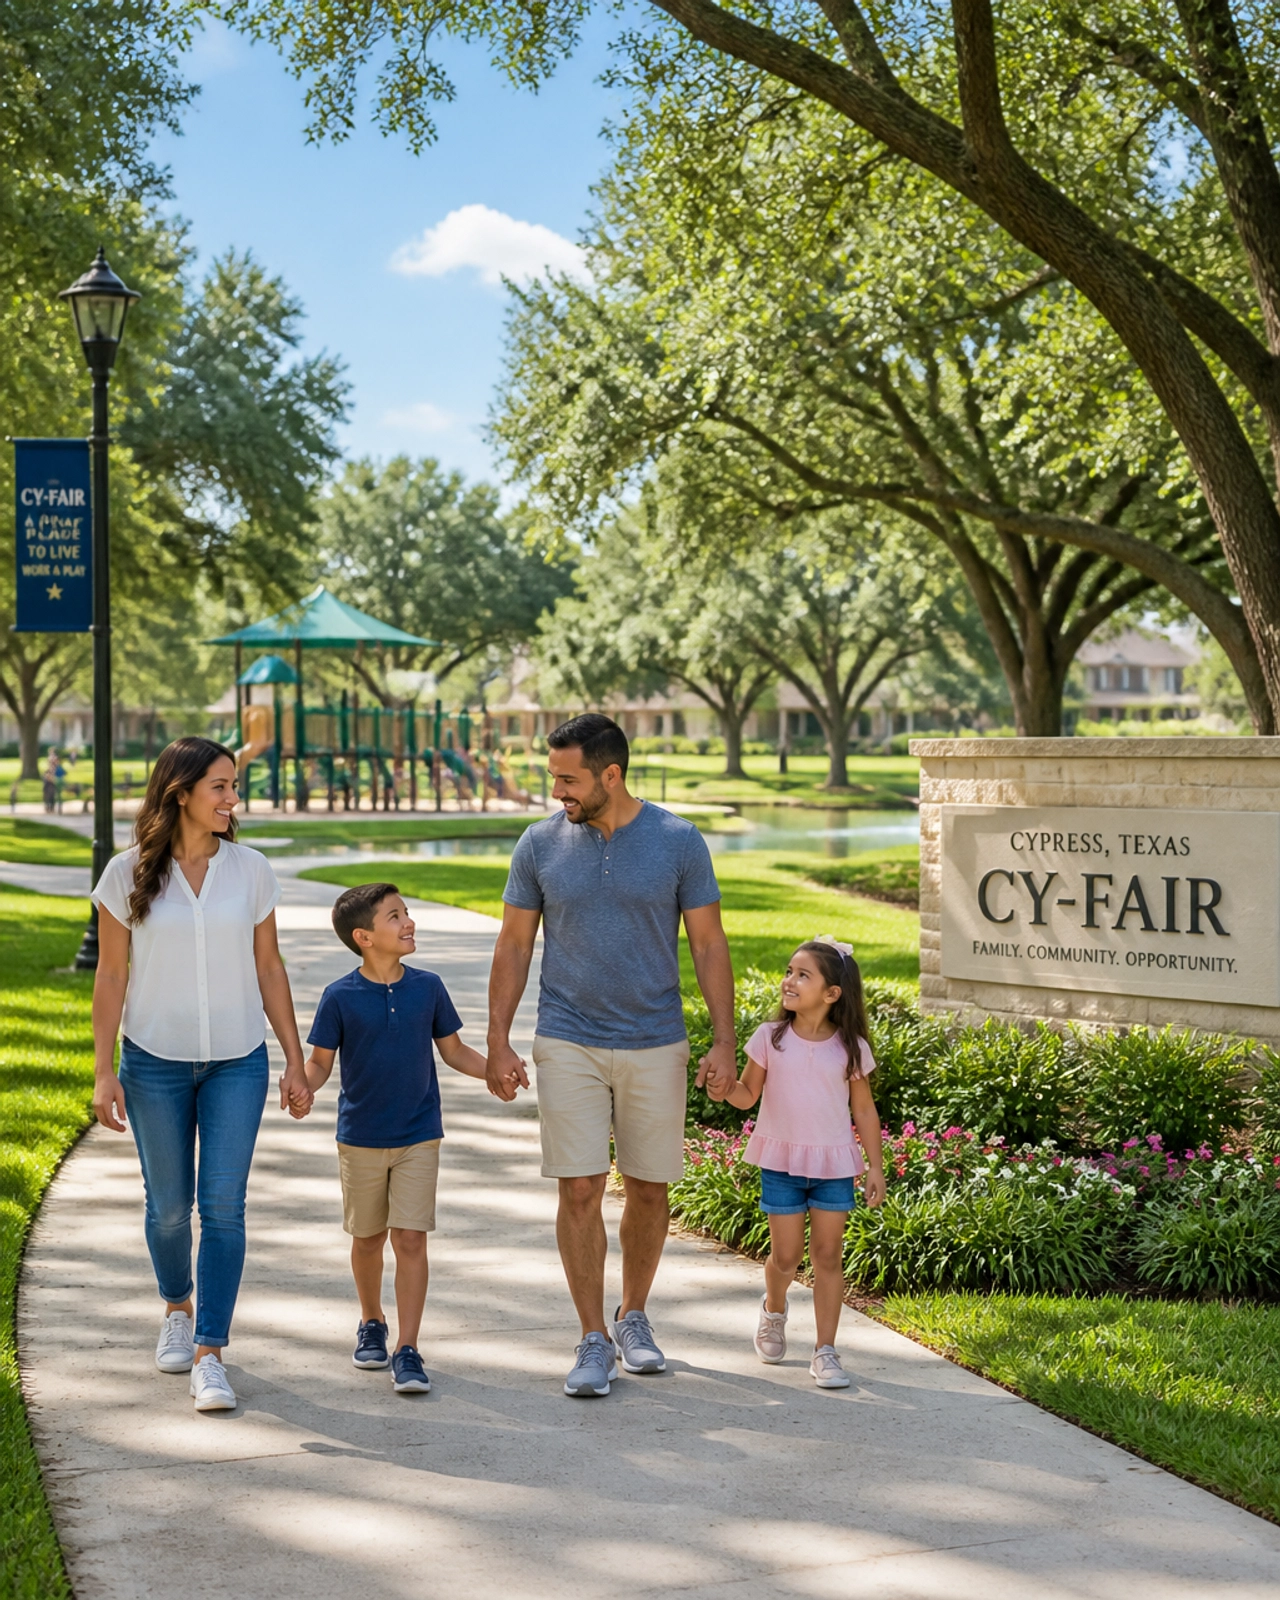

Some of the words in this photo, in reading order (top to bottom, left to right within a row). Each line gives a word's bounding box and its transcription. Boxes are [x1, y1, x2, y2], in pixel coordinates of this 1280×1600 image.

[21, 487, 86, 507] CY-FAIR
[27, 545, 47, 559] TO
[50, 545, 81, 560] LIVE
[1010, 831, 1110, 858] CYPRESS,
[1118, 833, 1191, 857] TEXAS
[977, 868, 1231, 936] CY-FAIR
[972, 940, 1023, 959] FAMILY.
[1027, 944, 1120, 966] COMMUNITY.
[1125, 951, 1239, 974] OPPORTUNITY.
